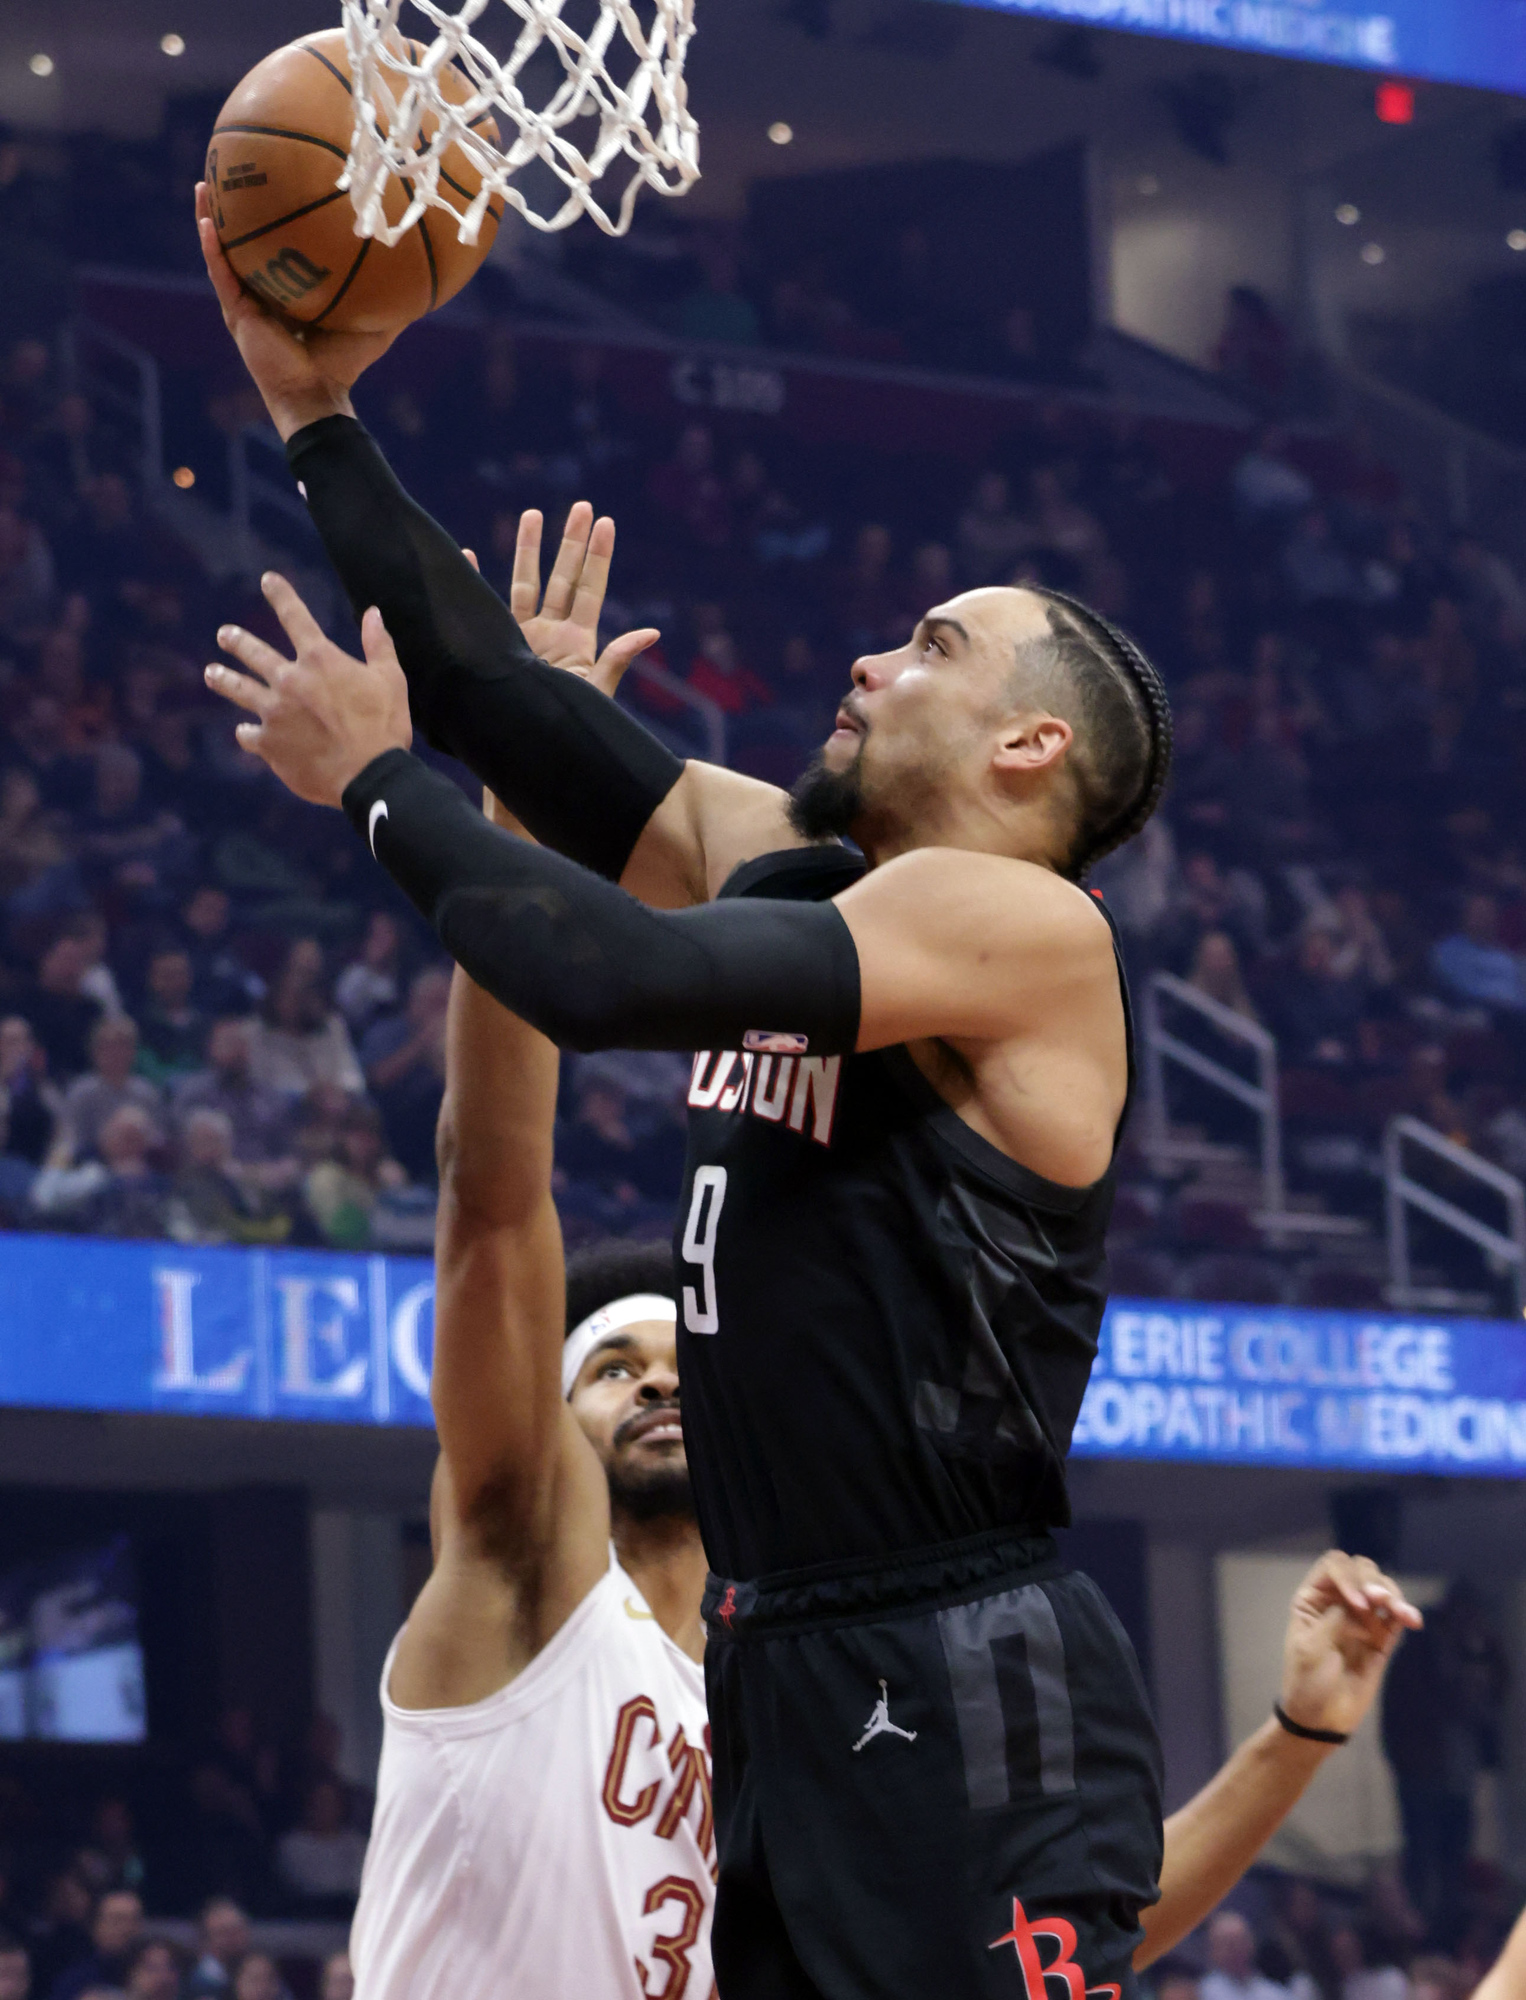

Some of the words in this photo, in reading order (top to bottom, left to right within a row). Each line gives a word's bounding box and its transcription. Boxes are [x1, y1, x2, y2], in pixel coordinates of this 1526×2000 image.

[682, 1165, 728, 1335] 9
[1111, 1311, 1224, 1380] ERIE
[1231, 1320, 1454, 1391] COLLEGE
